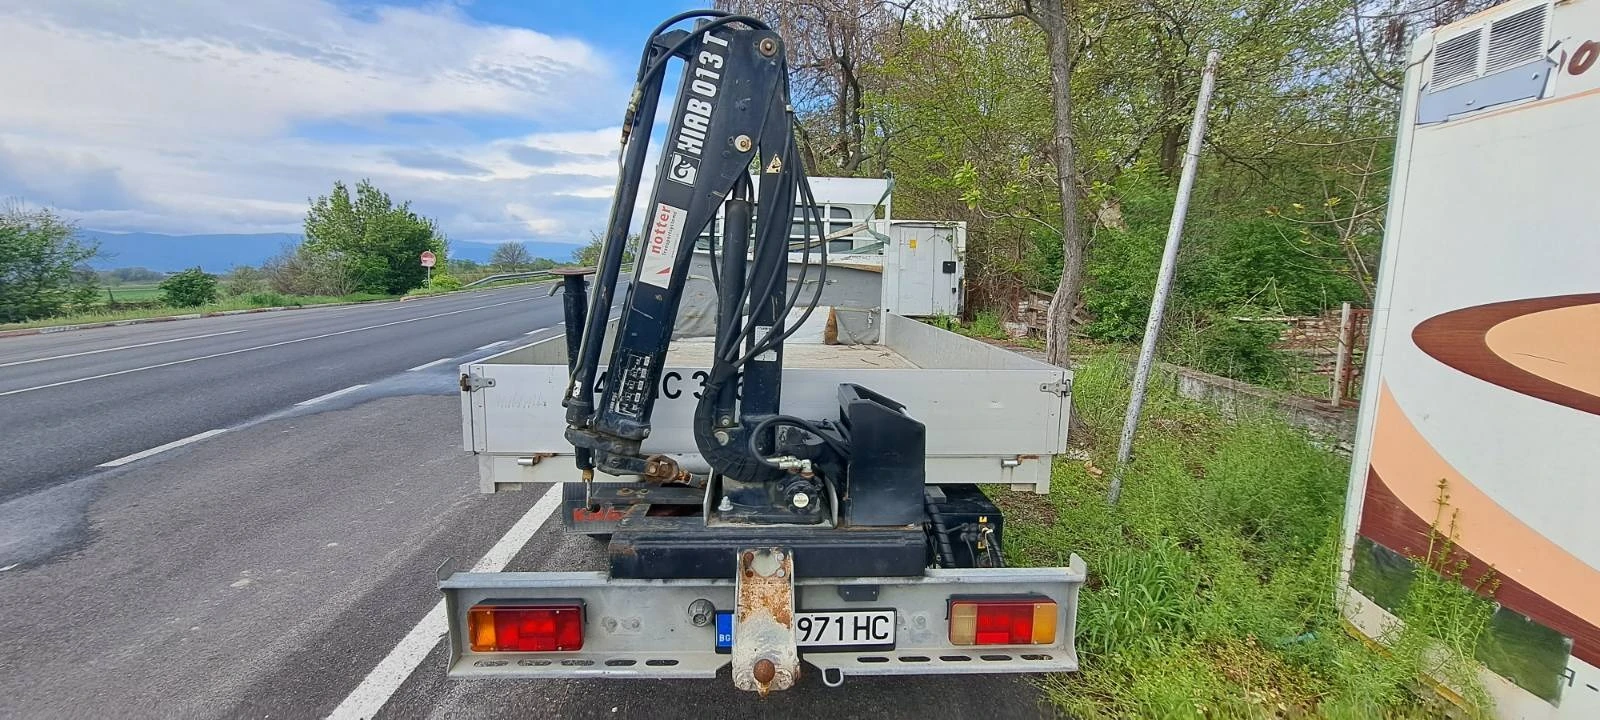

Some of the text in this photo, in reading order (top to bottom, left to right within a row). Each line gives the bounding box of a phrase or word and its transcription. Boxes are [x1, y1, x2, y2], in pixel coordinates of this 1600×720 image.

[677, 30, 729, 155] HIAB 013 T
[652, 206, 671, 254] notter
[719, 634, 731, 642] BG
[797, 615, 889, 642] 971 HC
